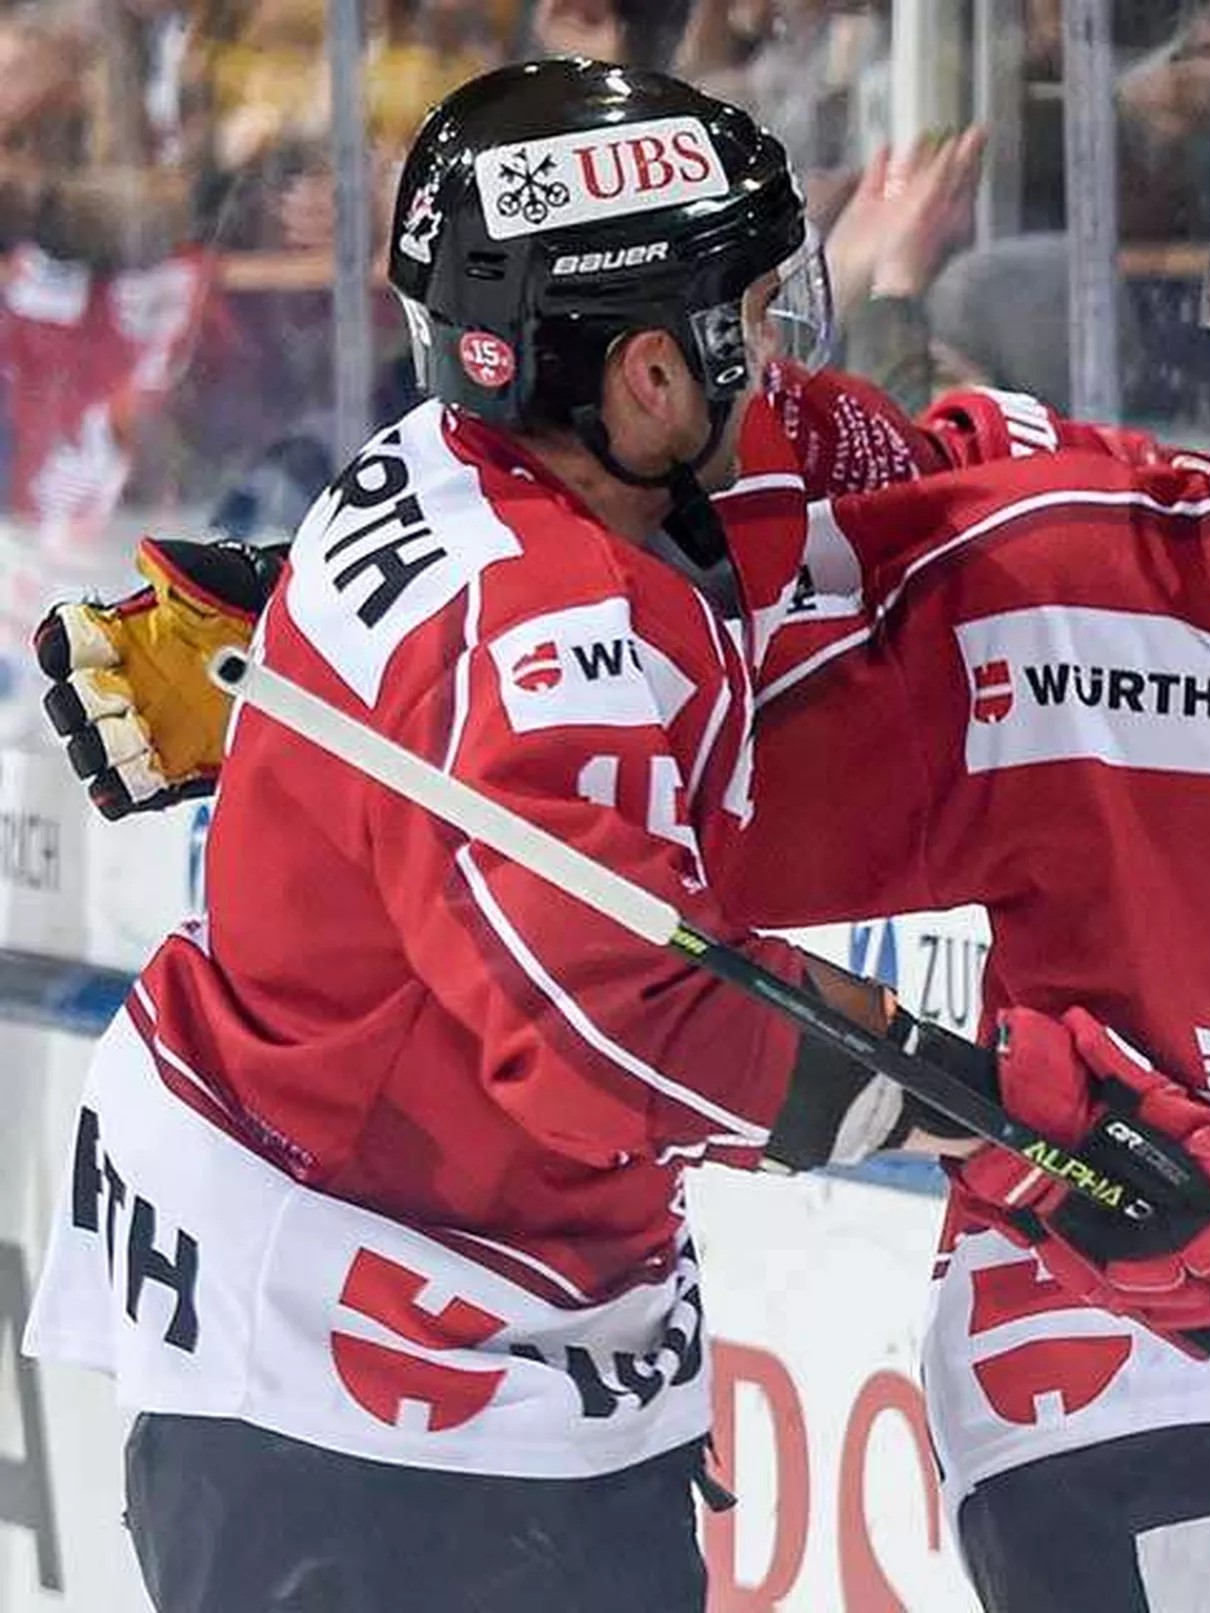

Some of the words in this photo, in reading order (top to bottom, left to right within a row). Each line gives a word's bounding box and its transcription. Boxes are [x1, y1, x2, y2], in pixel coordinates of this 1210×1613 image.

[572, 131, 711, 200] UBS
[552, 242, 669, 276] BAUER
[471, 339, 502, 368] 15
[322, 429, 448, 629] RTH
[1023, 1140, 1124, 1207] ALPHA
